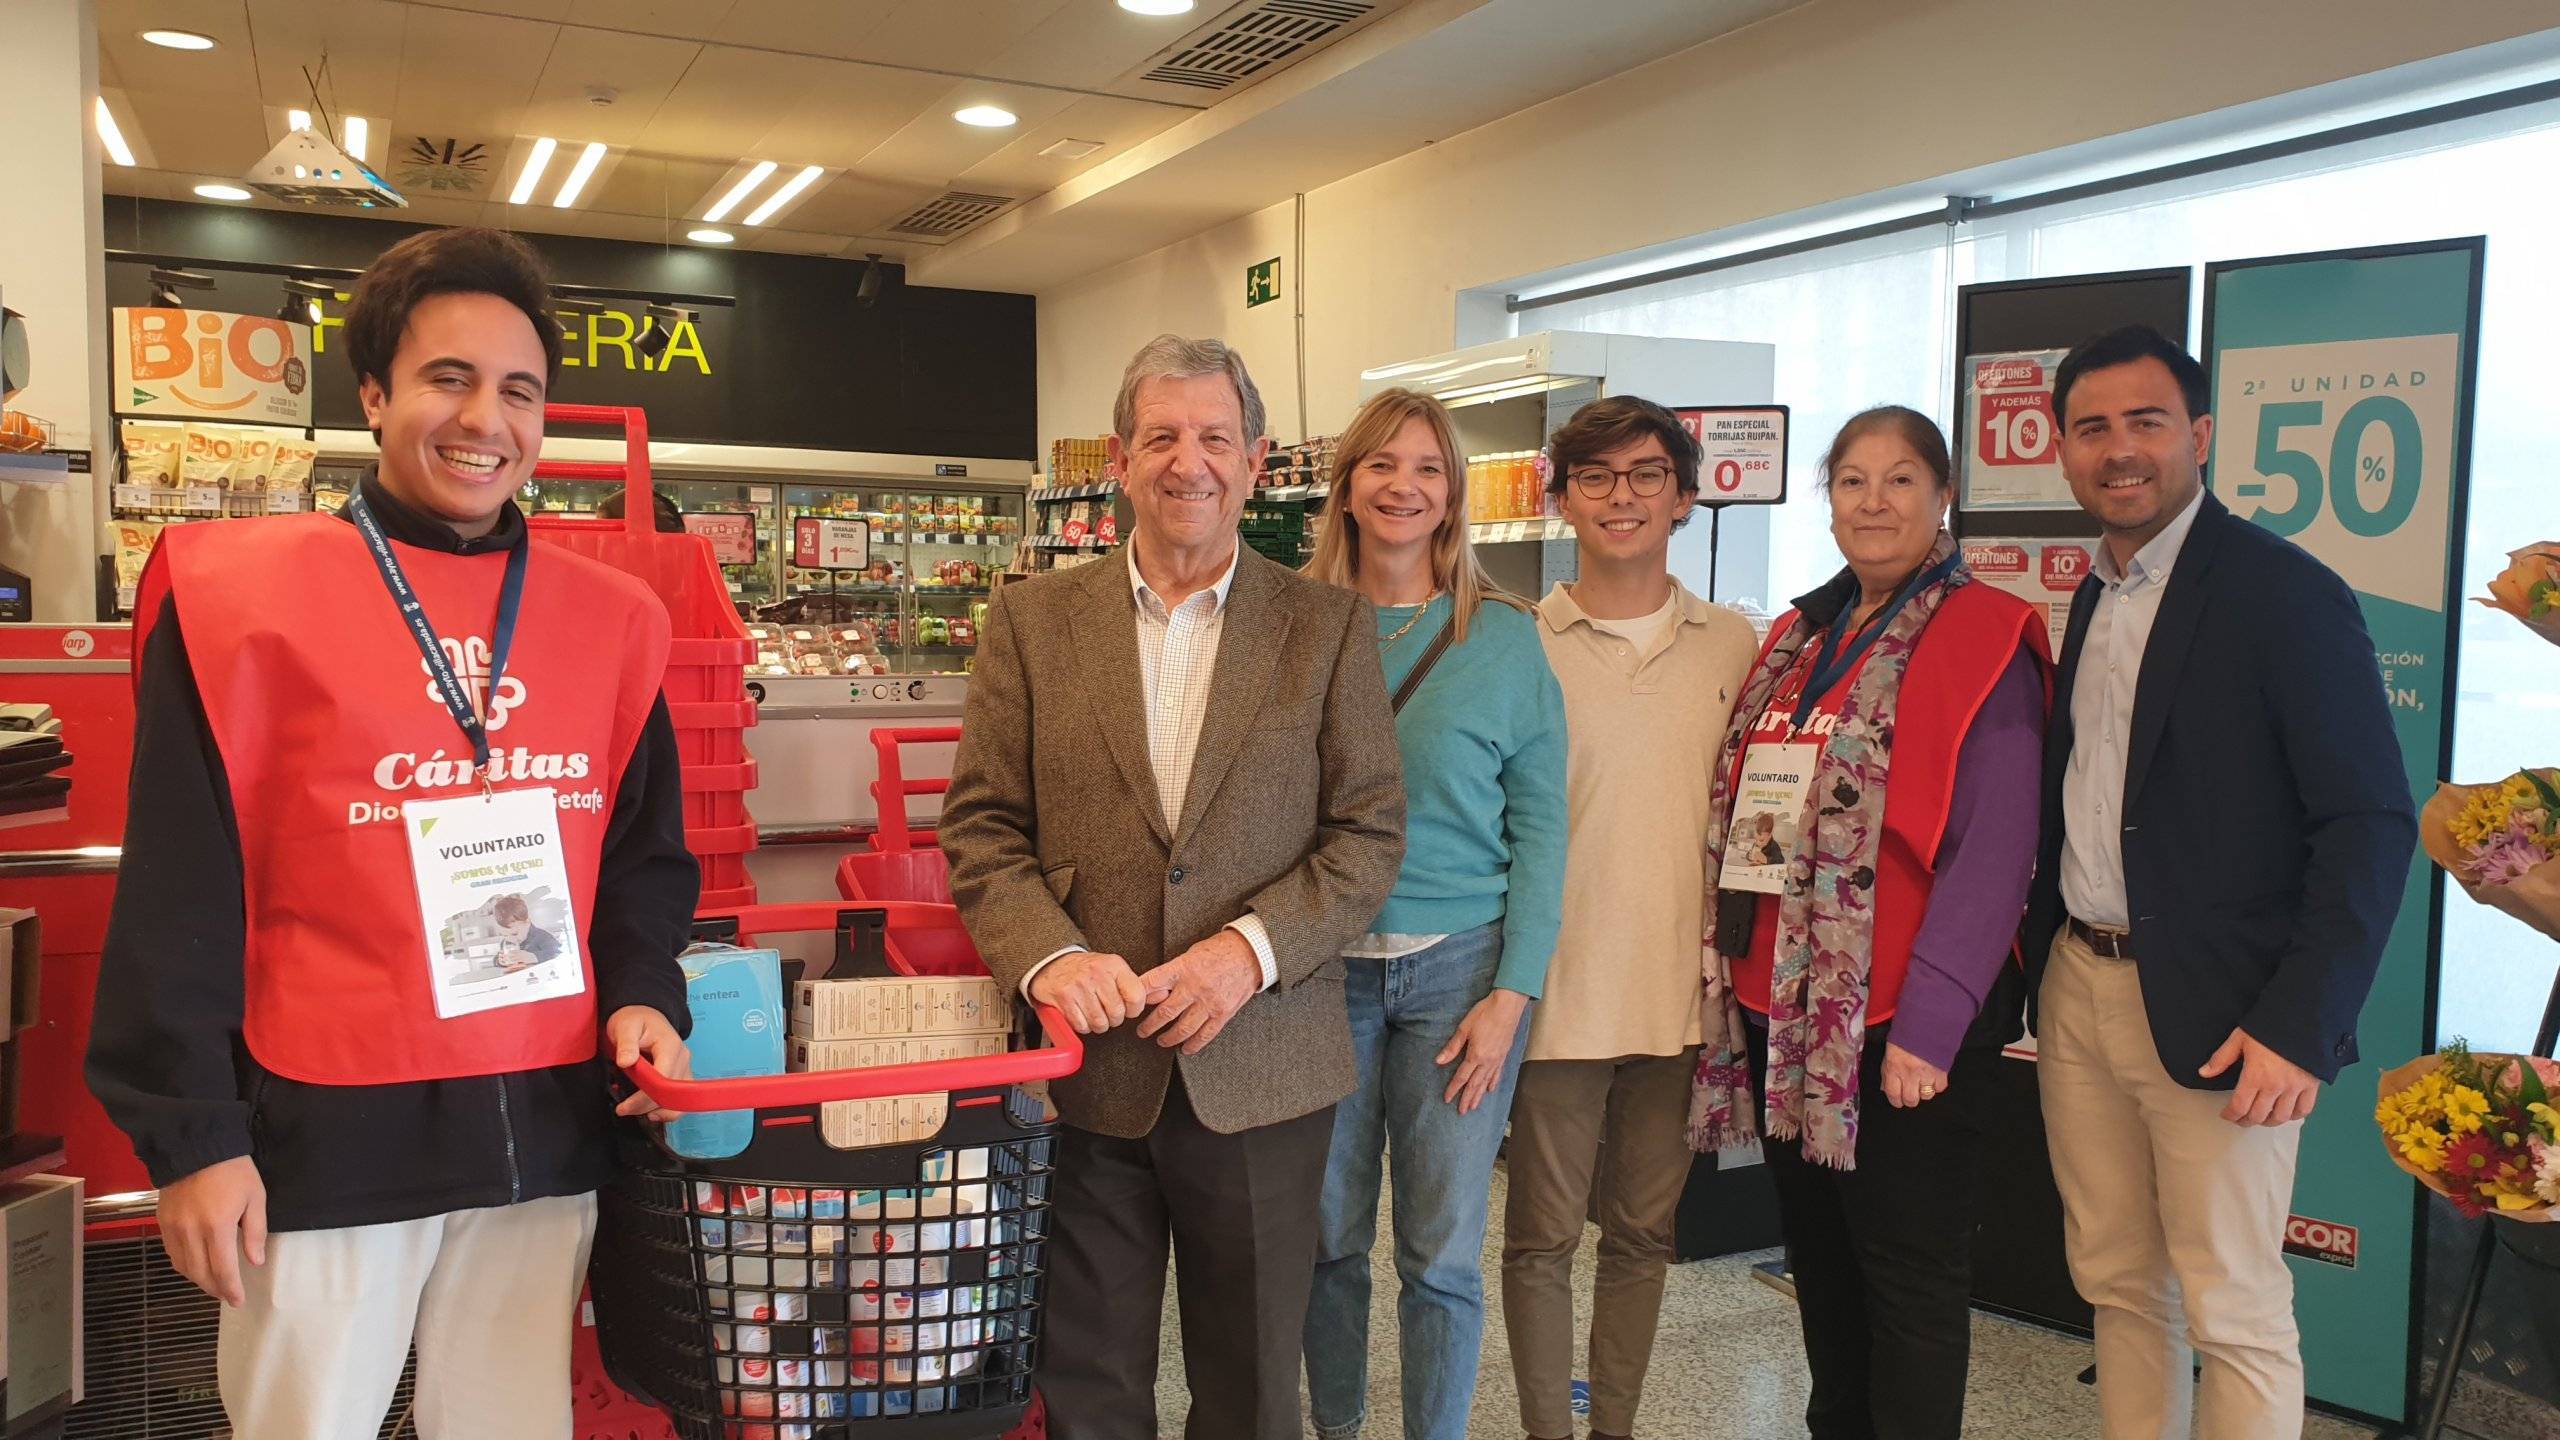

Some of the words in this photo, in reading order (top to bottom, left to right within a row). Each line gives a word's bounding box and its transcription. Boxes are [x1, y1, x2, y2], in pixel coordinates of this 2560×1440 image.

[1978, 367, 2033, 382] OFERTONES
[2243, 380, 2267, 396] 2ª
[2290, 370, 2427, 393] UNIDAD
[1991, 398, 1999, 408] Y
[2000, 395, 2042, 407] ADEMÁS
[1716, 420, 1732, 430] PAN
[1733, 419, 1770, 430] ESPECIAL
[1707, 431, 1745, 442] TORRIJAS
[187, 432, 233, 460] BiO
[804, 533, 812, 547] 3
[1964, 552, 2019, 565] OFERTONES
[63, 635, 86, 652] iarp
[2384, 669, 2394, 681] E
[373, 746, 590, 792] Cáritas
[1747, 772, 1800, 784] VOLUNTARIO
[551, 786, 604, 815] etafe
[439, 832, 546, 860] VOLUNTARIO
[703, 989, 740, 1000] entera
[2285, 1220, 2353, 1254] COR
